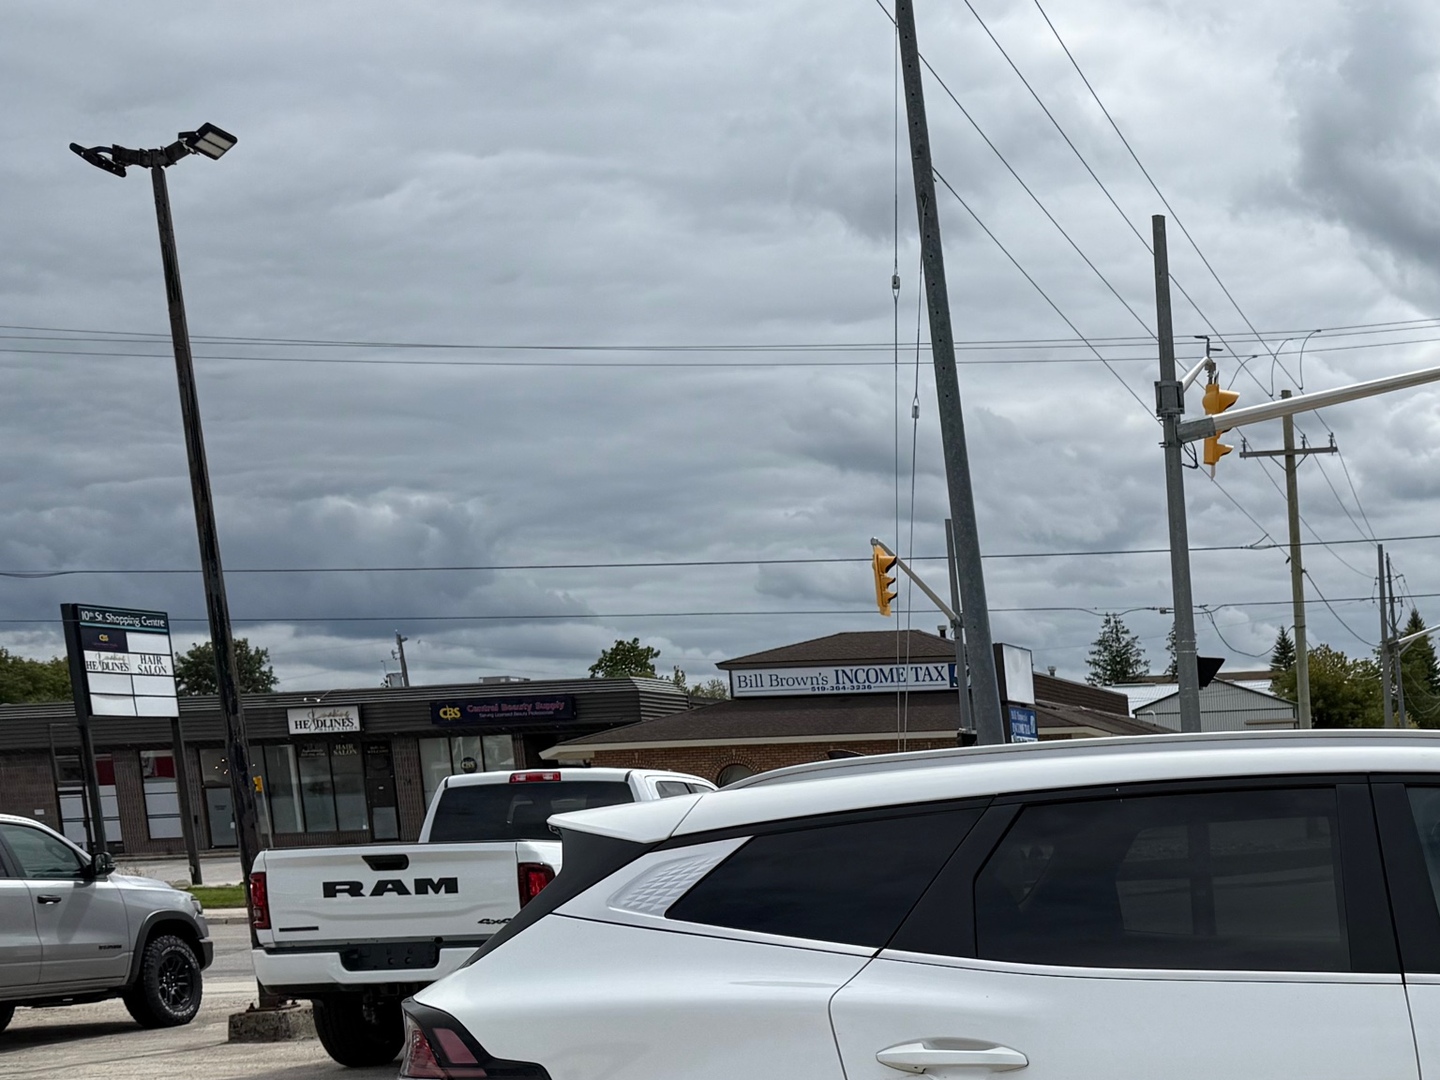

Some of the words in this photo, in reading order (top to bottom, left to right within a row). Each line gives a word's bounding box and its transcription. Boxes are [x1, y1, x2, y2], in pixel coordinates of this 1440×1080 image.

[81, 610, 94, 621] 10th
[105, 612, 140, 628] Shopping
[141, 616, 165, 627] Centre
[140, 654, 163, 665] HAIR
[138, 665, 167, 675] SALON
[737, 673, 764, 688] Bill
[769, 671, 829, 687] Brown's
[834, 665, 906, 685] INCOME
[910, 665, 947, 683] TAX
[439, 704, 461, 720] CBS
[466, 703, 498, 713] Central
[501, 703, 532, 712] Beauty
[535, 700, 565, 711] Supply
[322, 877, 459, 898] RAM
